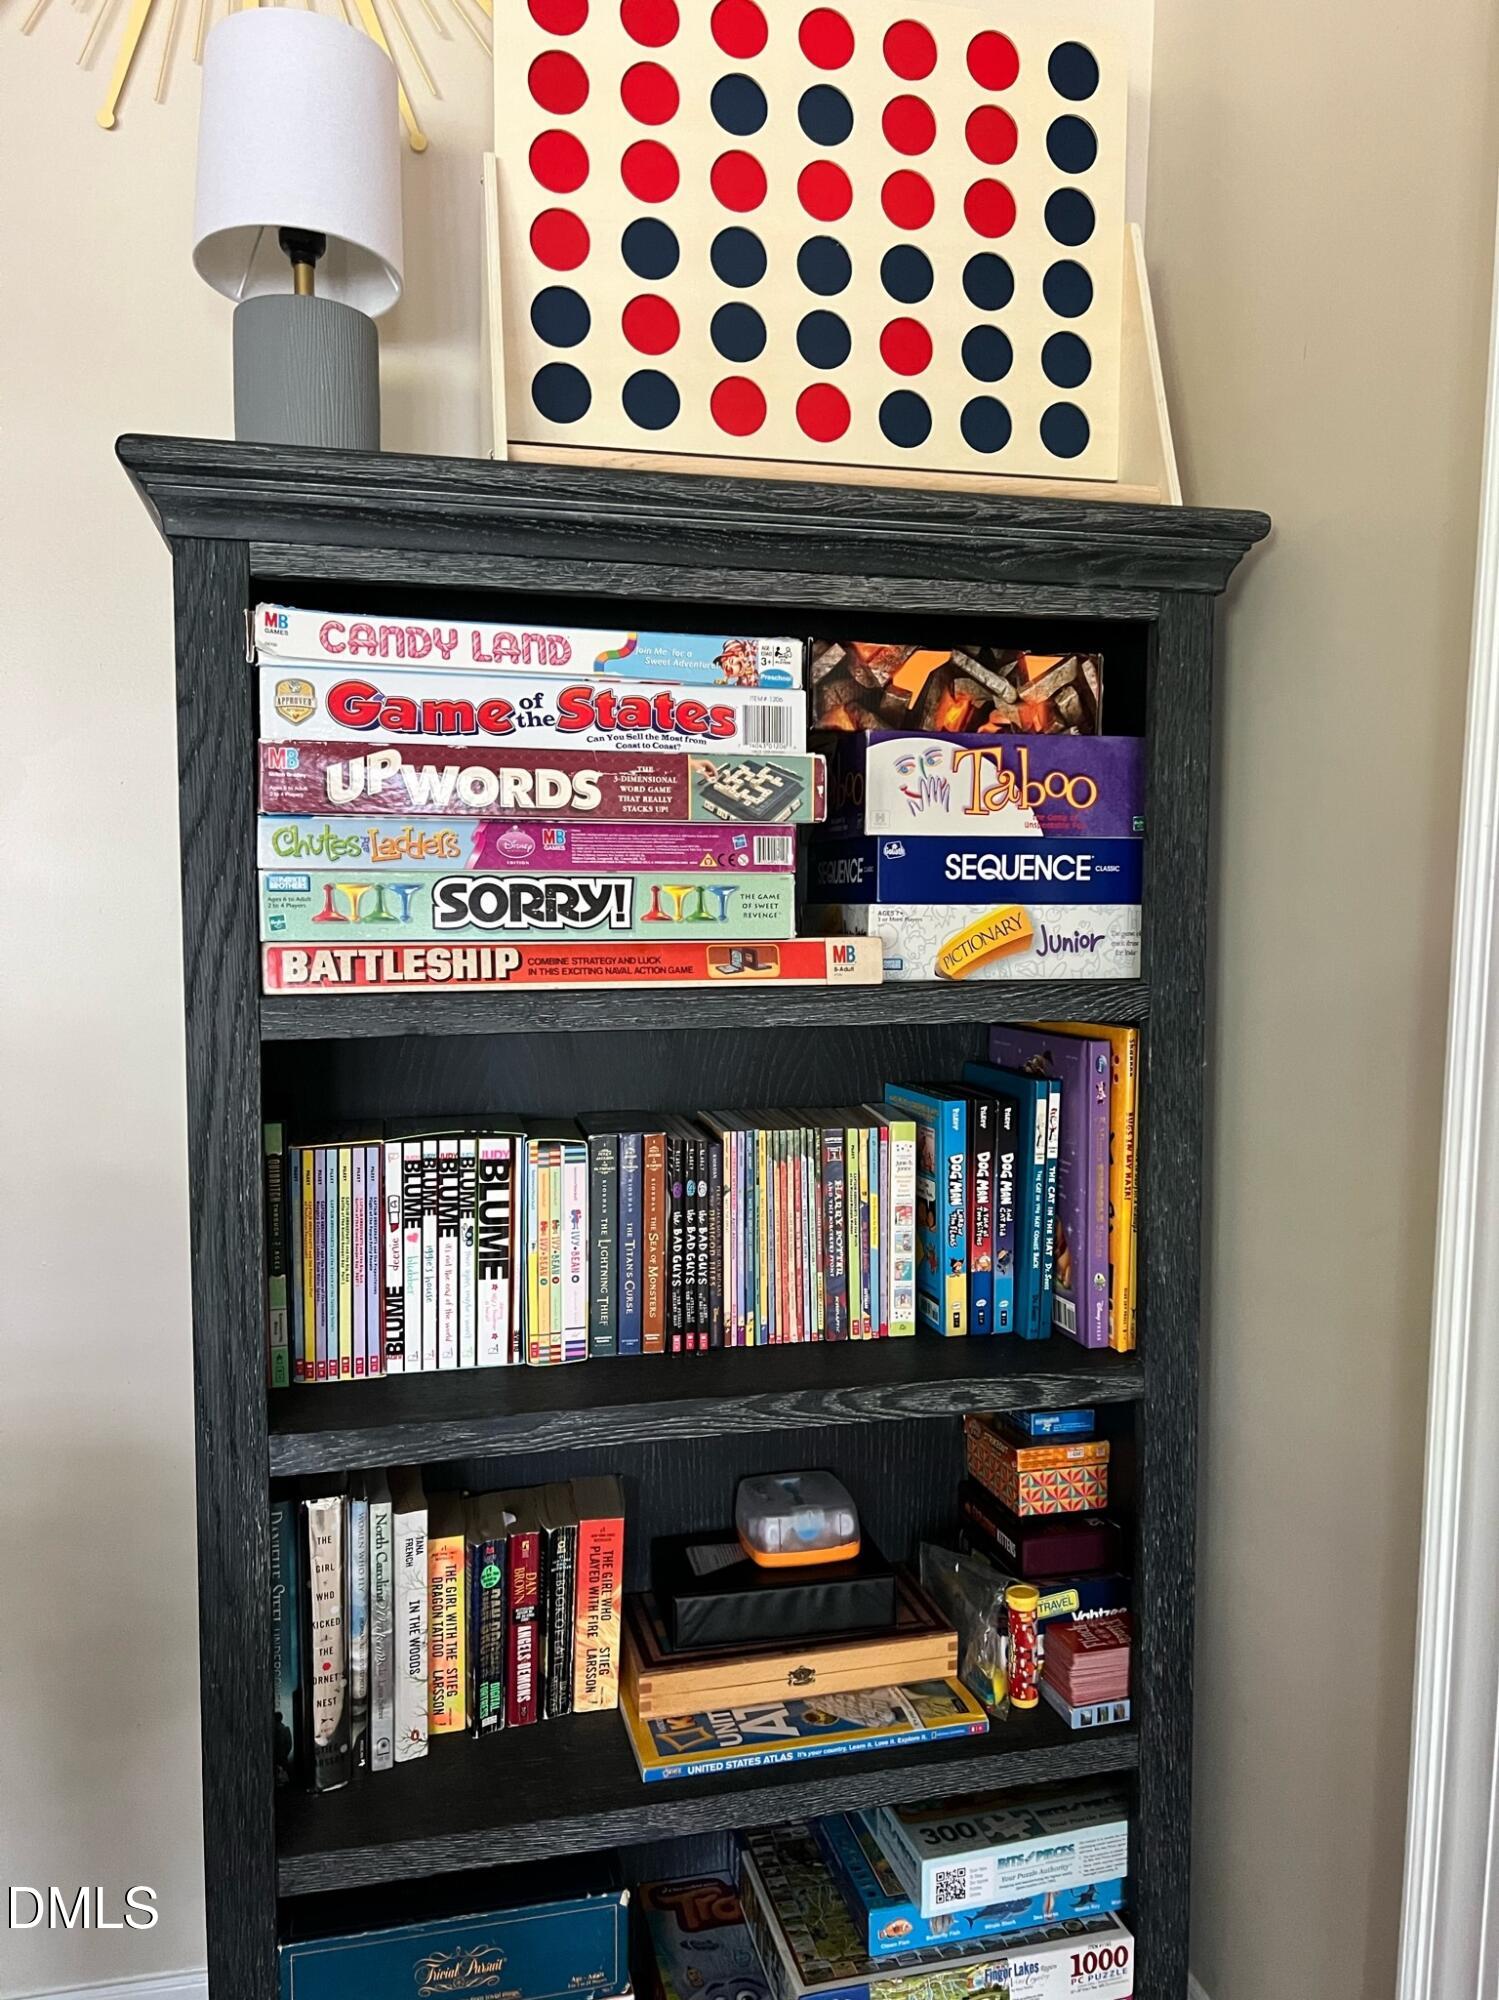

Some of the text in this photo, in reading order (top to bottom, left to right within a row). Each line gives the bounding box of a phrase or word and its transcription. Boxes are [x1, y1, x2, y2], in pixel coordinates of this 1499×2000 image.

[264, 628, 289, 636] GAMES
[265, 611, 289, 629] MB
[319, 620, 573, 667] CANDY LAND
[635, 647, 652, 655] Join
[644, 656, 671, 666] Sweet
[326, 679, 544, 735] Game of
[516, 686, 738, 739] the States
[586, 733, 707, 745] Can You Sell the Most from
[615, 742, 681, 750] Coast to Coast?
[268, 746, 299, 769] MB
[326, 749, 603, 811] UPWORDS
[613, 775, 678, 783] 3-DIMENSIONAL
[620, 785, 672, 794] WORD GAME
[953, 746, 1097, 815] Taboo
[618, 795, 673, 803] THAT REALLY
[271, 824, 362, 862] Chutes
[367, 825, 461, 862] Ladders
[502, 839, 533, 854] Disney
[543, 829, 566, 845] MB
[817, 857, 864, 886] SEQUENCE
[945, 854, 1120, 881] SEQUENCE CLASSIC
[437, 880, 630, 925] SORRY!
[942, 912, 1024, 970] PICTIONARY
[1035, 924, 1105, 957] Junior
[282, 947, 521, 984] BATTLESHIP
[527, 956, 661, 966] COMBINE STRATEGY AND LUCK
[832, 945, 856, 963] MB
[528, 966, 694, 976] IN THIS EXCITING NAVAL ACTION GAME
[952, 1107, 960, 1130] PILKEY
[980, 1106, 988, 1128] PILKEY
[949, 1154, 963, 1206] DOG MAN
[976, 1151, 990, 1203] DOG MAN
[1000, 1153, 1014, 1204] DOG MAN
[1048, 1166, 1056, 1182] THE
[404, 1160, 422, 1229] BLUME
[423, 1158, 437, 1216] BLUME
[439, 1159, 458, 1238] BLUME
[460, 1157, 476, 1219] BLUME
[1047, 1186, 1055, 1203] CAT
[479, 1159, 510, 1280] BLUME
[673, 1211, 682, 1226] the
[687, 1209, 696, 1224] the
[698, 1210, 707, 1224] the
[1047, 1207, 1053, 1215] IN
[673, 1228, 682, 1252] BAD
[687, 1226, 696, 1250] BAD
[699, 1227, 708, 1250] BAD
[834, 1180, 843, 1276] HARRY POTTER
[571, 1231, 580, 1273] IVY BEAN
[648, 1233, 660, 1251] SEA
[1045, 1238, 1053, 1256] HAT
[624, 1240, 636, 1278] TITAN'S
[650, 1254, 657, 1264] OF
[672, 1255, 682, 1287] GUYS
[686, 1253, 695, 1285] GUYS
[698, 1253, 708, 1285] GUYS
[596, 1218, 612, 1327] THE LIGHTNING THIEF
[624, 1280, 636, 1314] CURSE
[648, 1266, 659, 1318] MONSTERS
[386, 1287, 403, 1355] BLUME
[316, 1535, 332, 1545] THE
[415, 1536, 424, 1555] TANA
[375, 1513, 390, 1603] North Carolina
[405, 1538, 414, 1568] FRENCH
[602, 1550, 614, 1569] THE
[315, 1563, 335, 1573] GIRL
[445, 1564, 457, 1582] THE
[316, 1590, 335, 1601] WHO
[514, 1567, 525, 1604] BROWN
[525, 1572, 537, 1595] DAN
[587, 1545, 601, 1638] PLAYED WITH FIRE
[601, 1572, 613, 1595] GIRL
[445, 1586, 457, 1611] GIRL
[600, 1597, 612, 1621] WHO
[1038, 1597, 1074, 1613] TRAVEL
[312, 1618, 341, 1629] KICKED
[431, 1576, 443, 1657] DRAGON TATTOO
[446, 1612, 457, 1639] WITH
[409, 1600, 421, 1675] IN THE WOODS
[517, 1626, 531, 1661] ANGELS
[319, 1646, 334, 1656] THE
[446, 1641, 457, 1661] THE
[599, 1647, 610, 1675] STIEG
[446, 1668, 458, 1697] STIEG
[517, 1662, 531, 1703] DEMONS
[585, 1648, 597, 1693] LARSSON
[316, 1696, 337, 1707] NEST
[432, 1670, 444, 1715] LARSSON
[490, 1682, 500, 1712] DIGITAL
[687, 1753, 793, 1775] UNITED STATES ATLAS
[919, 1821, 977, 1845] 300
[1000, 1864, 1069, 1883] Your Puzzle Authority
[424, 1957, 504, 1984] Trivial Pursuit
[984, 1961, 1039, 1983] Finger Lakes
[1070, 1945, 1129, 1977] 1000
[1071, 1967, 1128, 1985] PC PUZZLE
